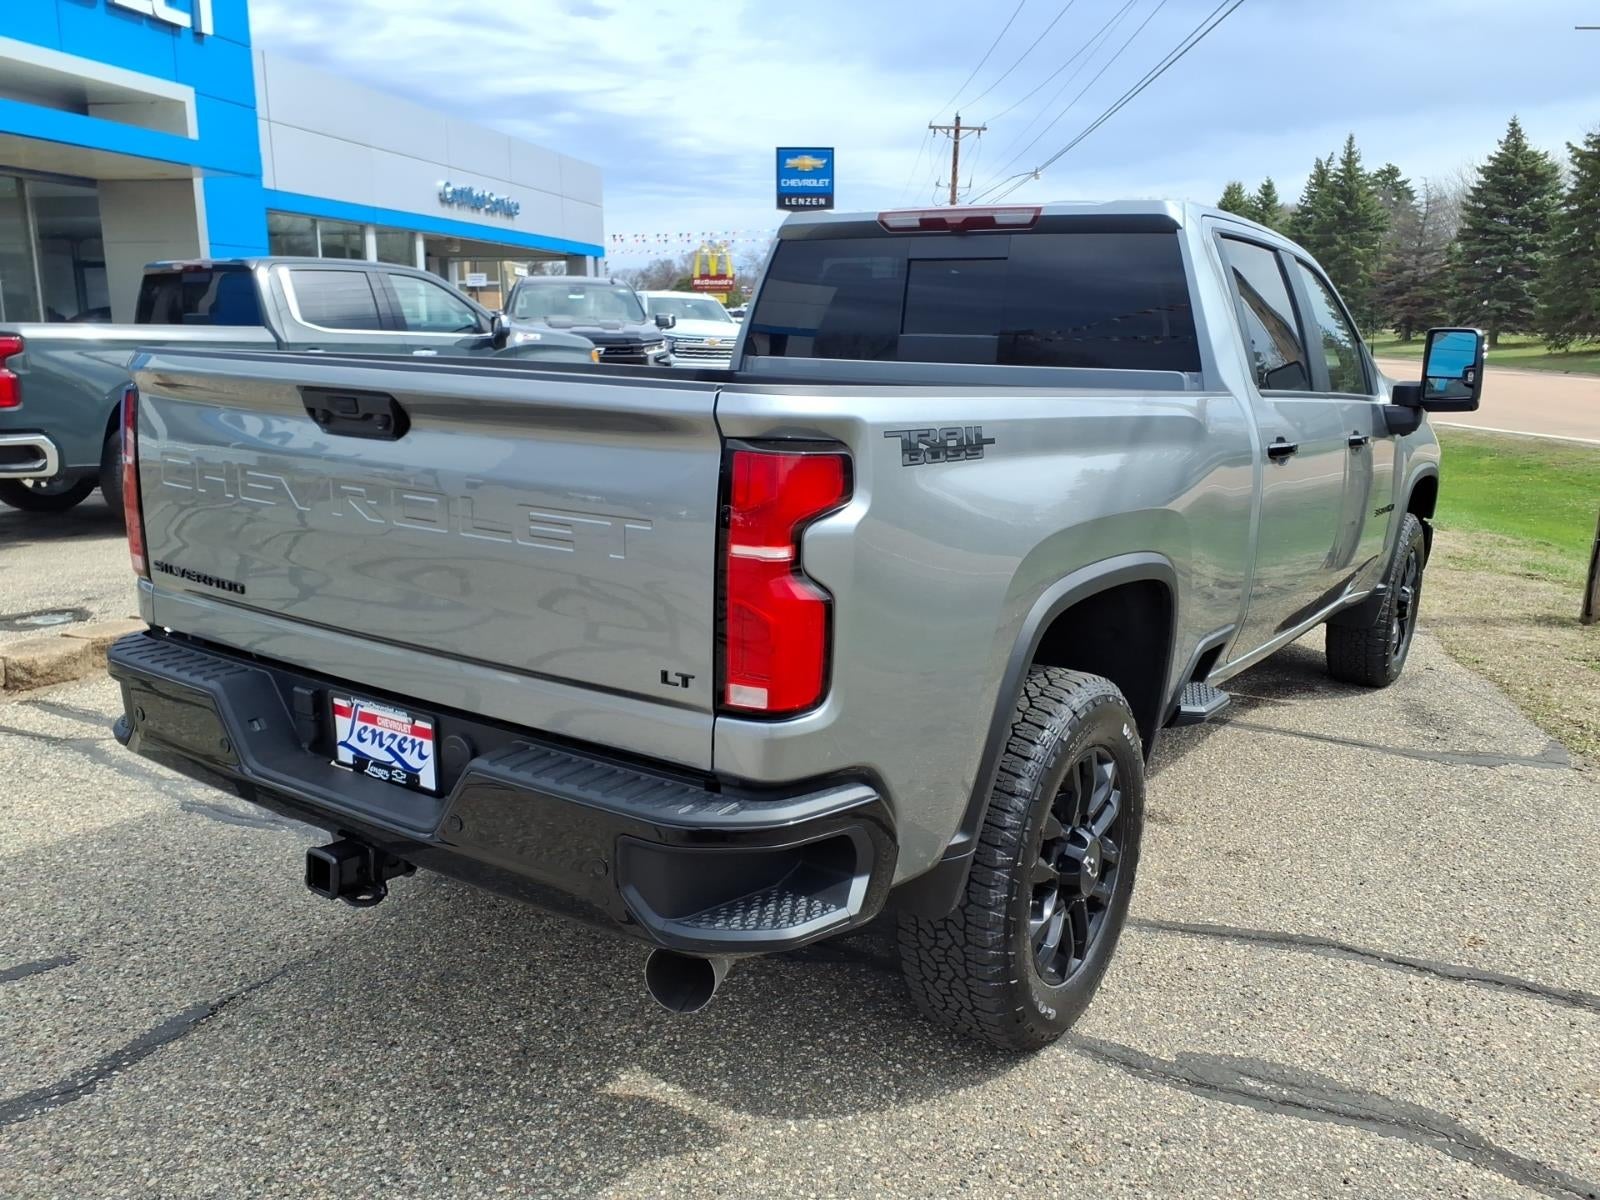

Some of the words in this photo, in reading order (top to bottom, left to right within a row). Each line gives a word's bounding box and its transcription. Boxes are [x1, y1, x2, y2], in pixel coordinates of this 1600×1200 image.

[781, 178, 830, 187] CHEVROLET
[785, 197, 826, 206] LENZEN
[884, 426, 995, 450] TRAIL
[901, 445, 984, 467] BOSS
[160, 451, 653, 560] CHEVROLET
[153, 560, 246, 595] SILVERADO
[660, 669, 695, 689] LT
[377, 716, 412, 734] CHEVROLET
[337, 703, 430, 774] Lenzen
